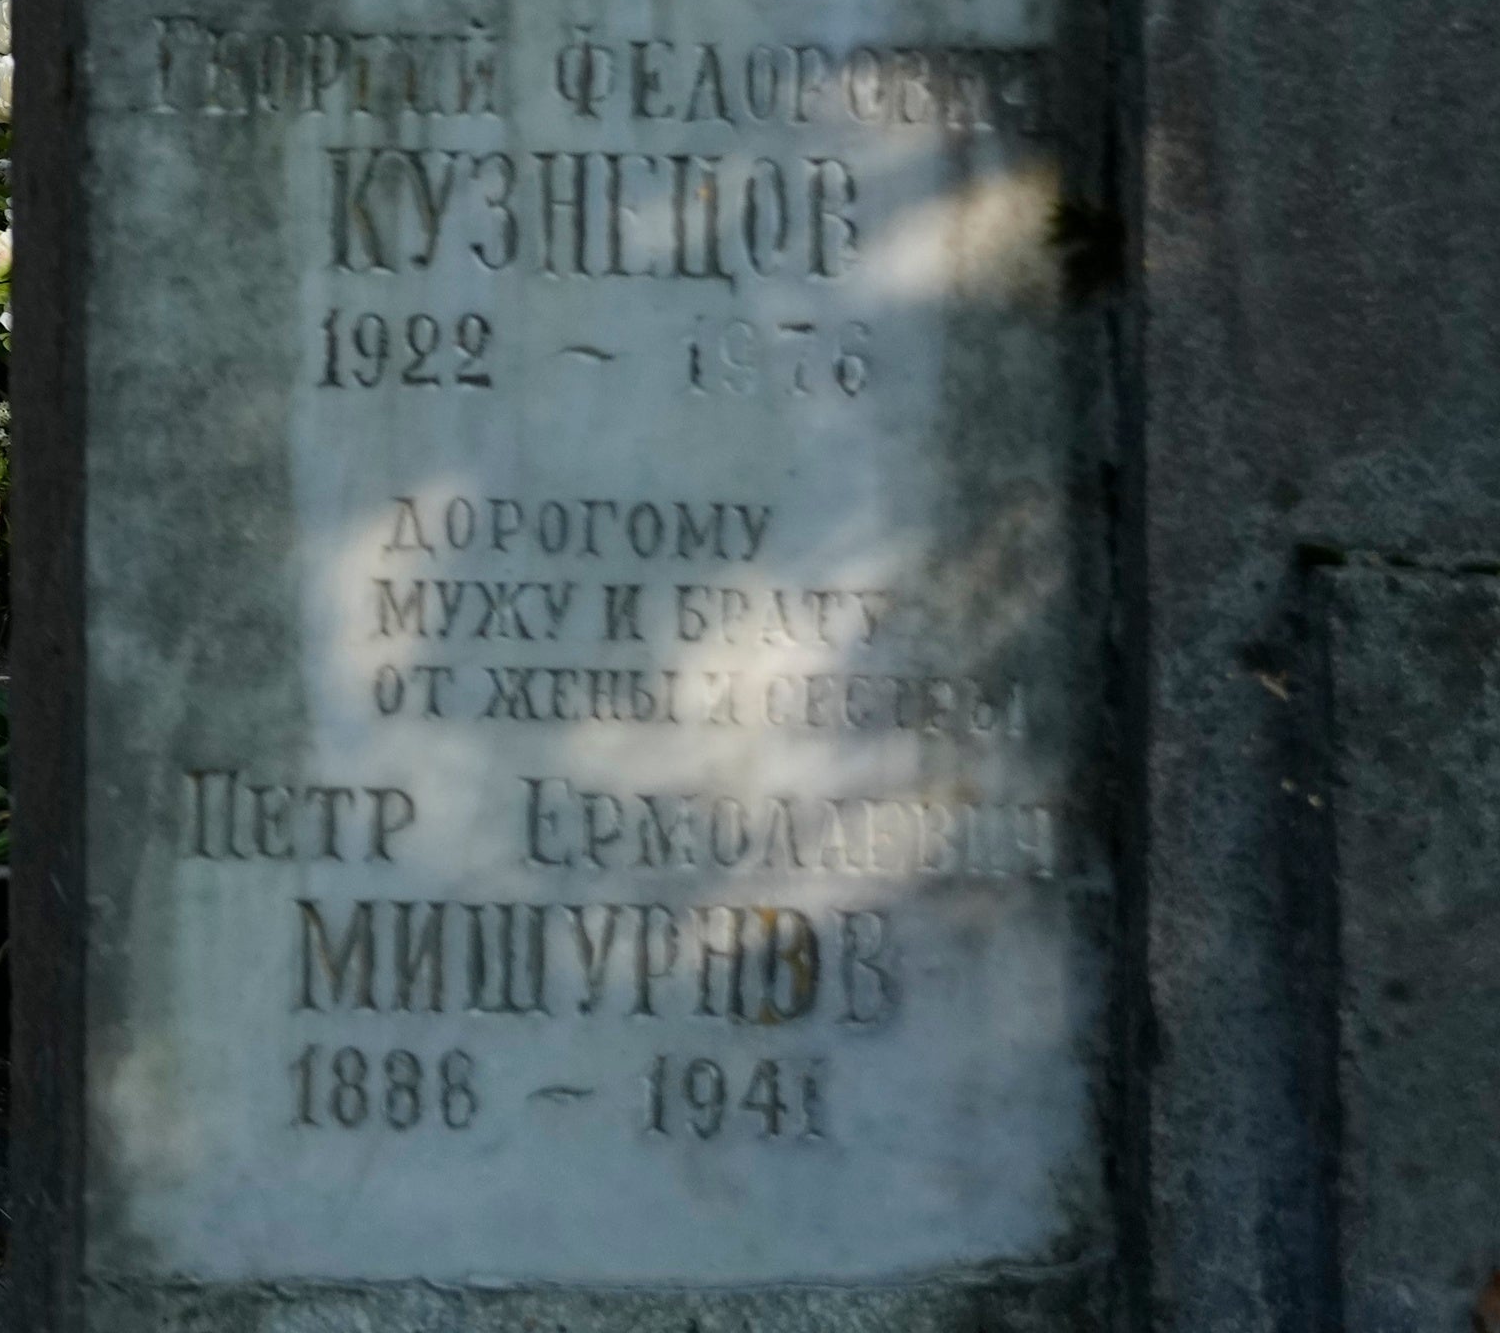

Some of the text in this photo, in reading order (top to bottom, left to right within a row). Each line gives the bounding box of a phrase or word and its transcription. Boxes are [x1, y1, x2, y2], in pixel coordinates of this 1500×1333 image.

[327, 146, 862, 287] КУЗНЕЦОВ
[318, 310, 495, 390] 1922
[381, 496, 773, 559] ДОРОГОМУ
[372, 578, 895, 649] МУЖУ И БРАТУ
[374, 665, 1026, 735] ОТ ЖЕНЫ И СЕСТРЫ
[183, 769, 417, 863] ПЕТР
[293, 898, 902, 1027] МИШУРНОВ
[643, 1053, 828, 1139] 1941
